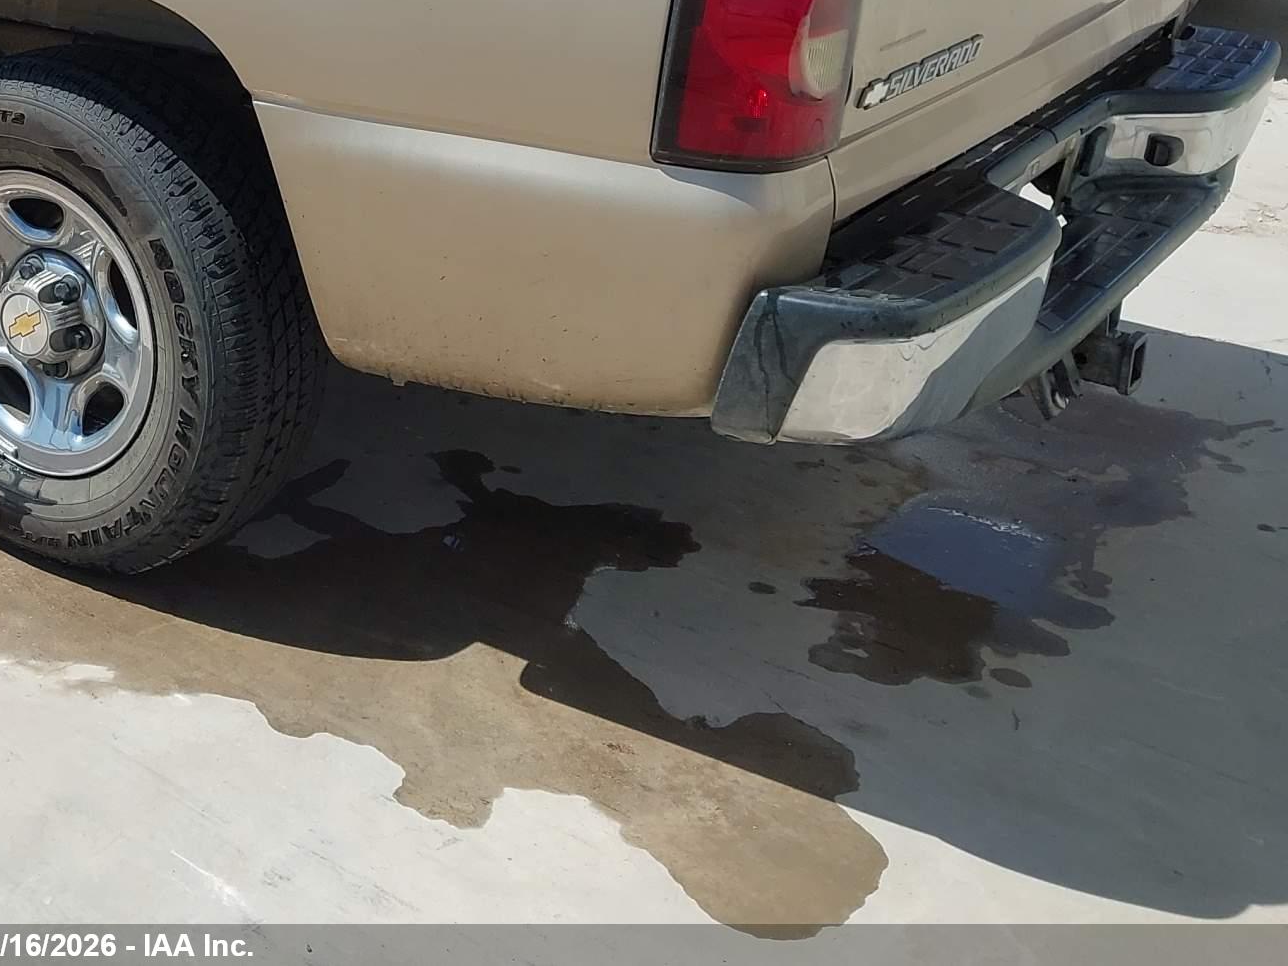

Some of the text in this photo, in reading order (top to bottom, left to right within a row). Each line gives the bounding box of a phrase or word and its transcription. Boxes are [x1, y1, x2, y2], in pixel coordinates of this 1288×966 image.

[886, 35, 984, 100] SILVERADO
[67, 238, 200, 548] ROCKY MOUNTAIN
